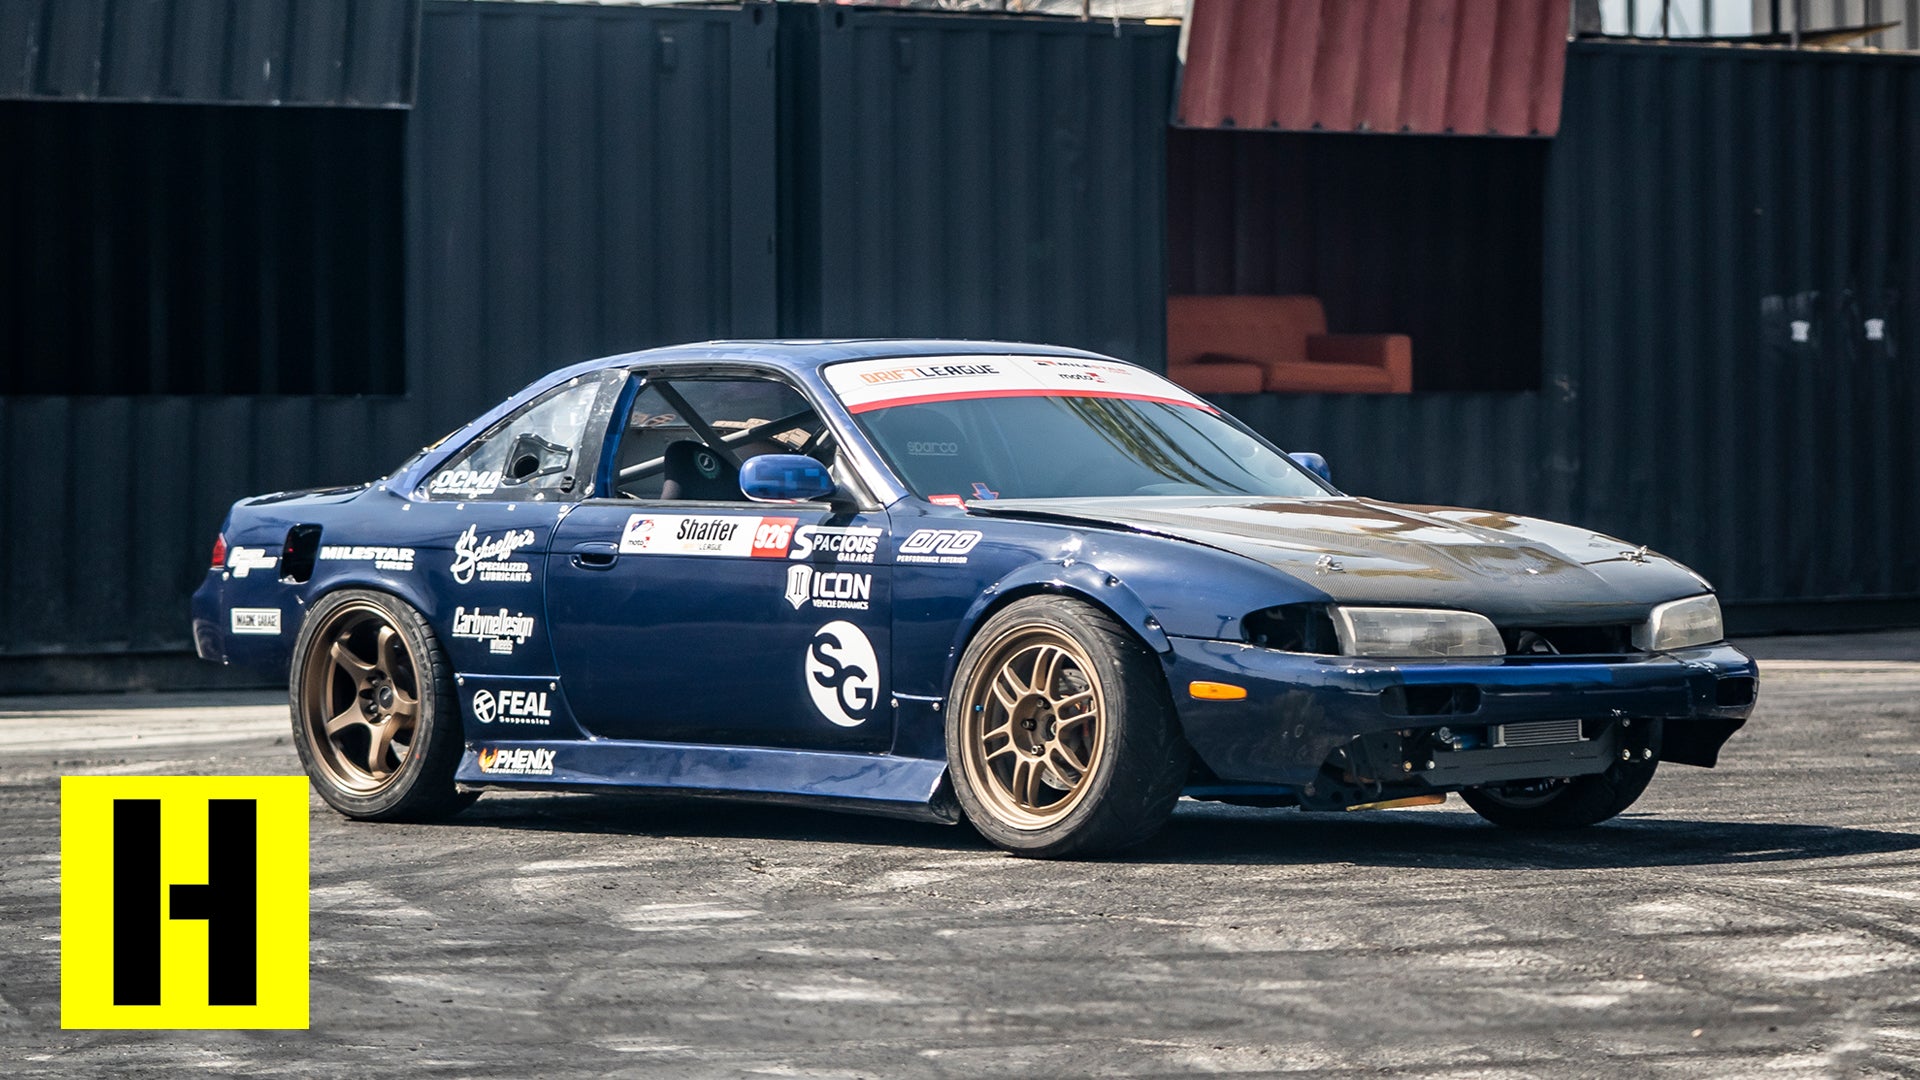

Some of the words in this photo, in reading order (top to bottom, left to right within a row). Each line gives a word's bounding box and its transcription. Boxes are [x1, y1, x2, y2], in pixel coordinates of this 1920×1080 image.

[907, 441, 959, 454] sparco
[677, 518, 739, 541] Shaffer
[754, 525, 792, 549] 926
[789, 524, 883, 559] SPACIOUS
[319, 546, 416, 561] MILESTAR
[837, 552, 875, 563] GARAGE
[480, 571, 532, 582] LUBRICANTS
[812, 571, 872, 600] ICON
[812, 599, 837, 609] VEHICLE
[836, 601, 869, 610] DYNAMICS
[452, 606, 534, 644] CarbyneDesign
[811, 631, 874, 722] SG
[497, 690, 552, 717] FEAL
[498, 716, 550, 726] Suspension
[493, 748, 556, 769] PHENIX
